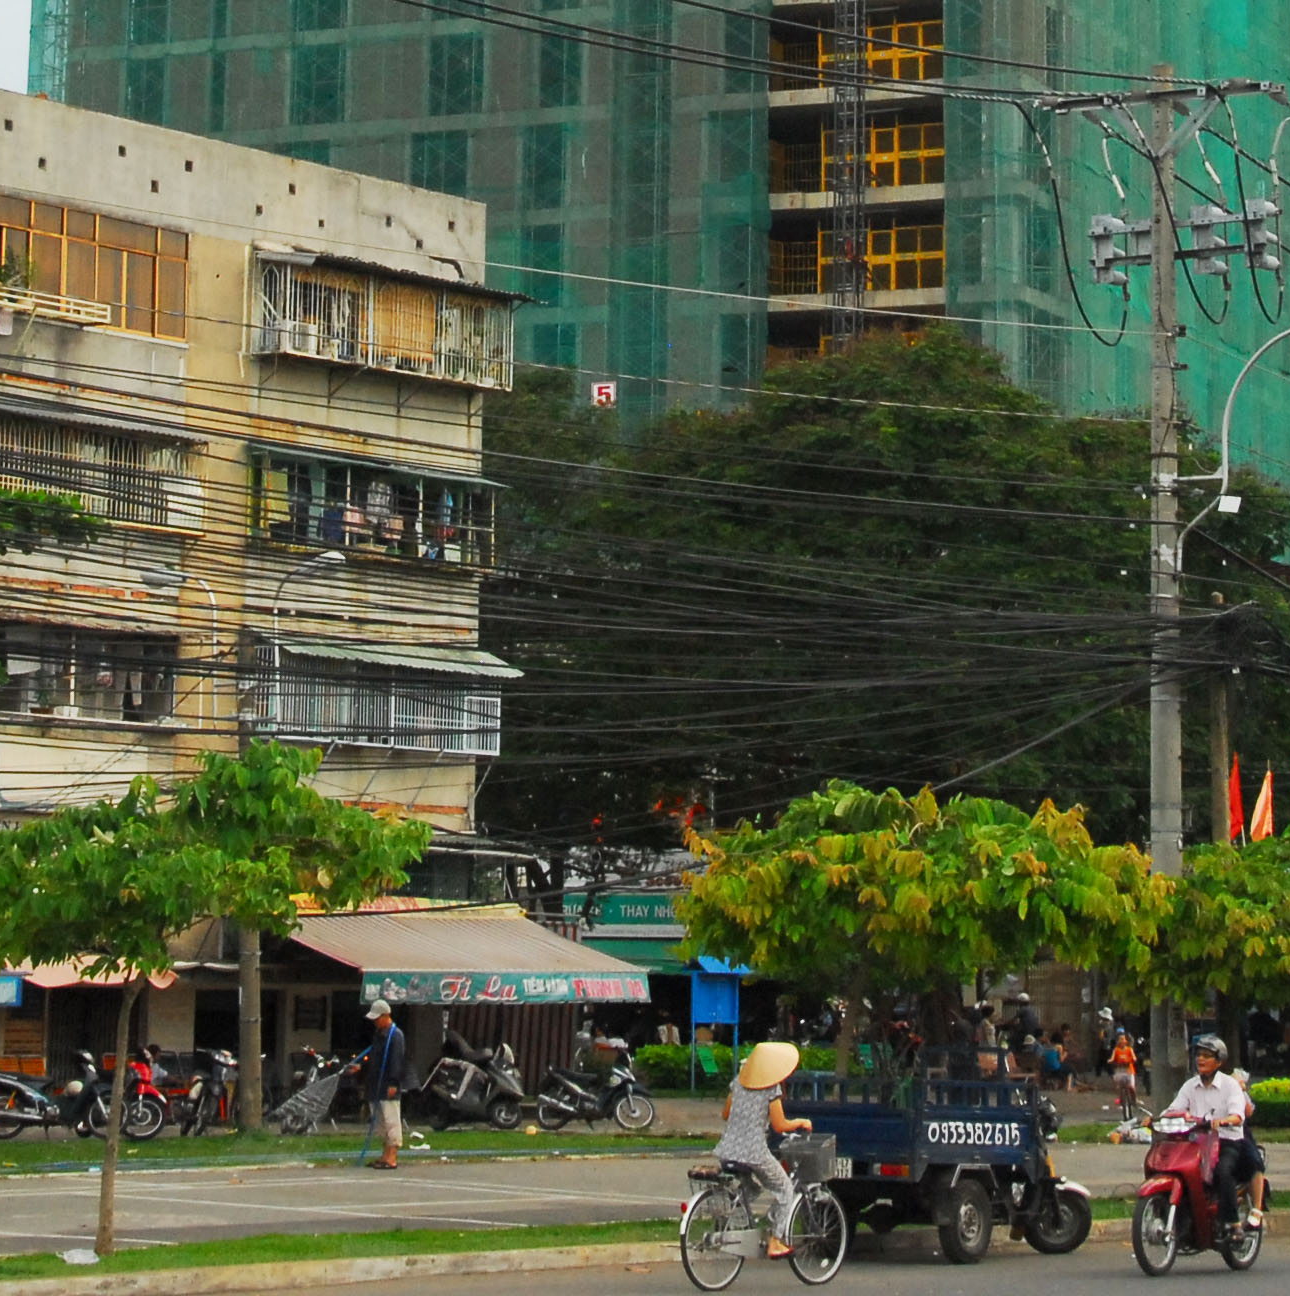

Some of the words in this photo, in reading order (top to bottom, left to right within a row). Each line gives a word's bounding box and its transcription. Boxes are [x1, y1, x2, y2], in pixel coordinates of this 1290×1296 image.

[596, 385, 612, 407] 5
[619, 904, 650, 918] THAY
[927, 1121, 1021, 1146] 0933982615
